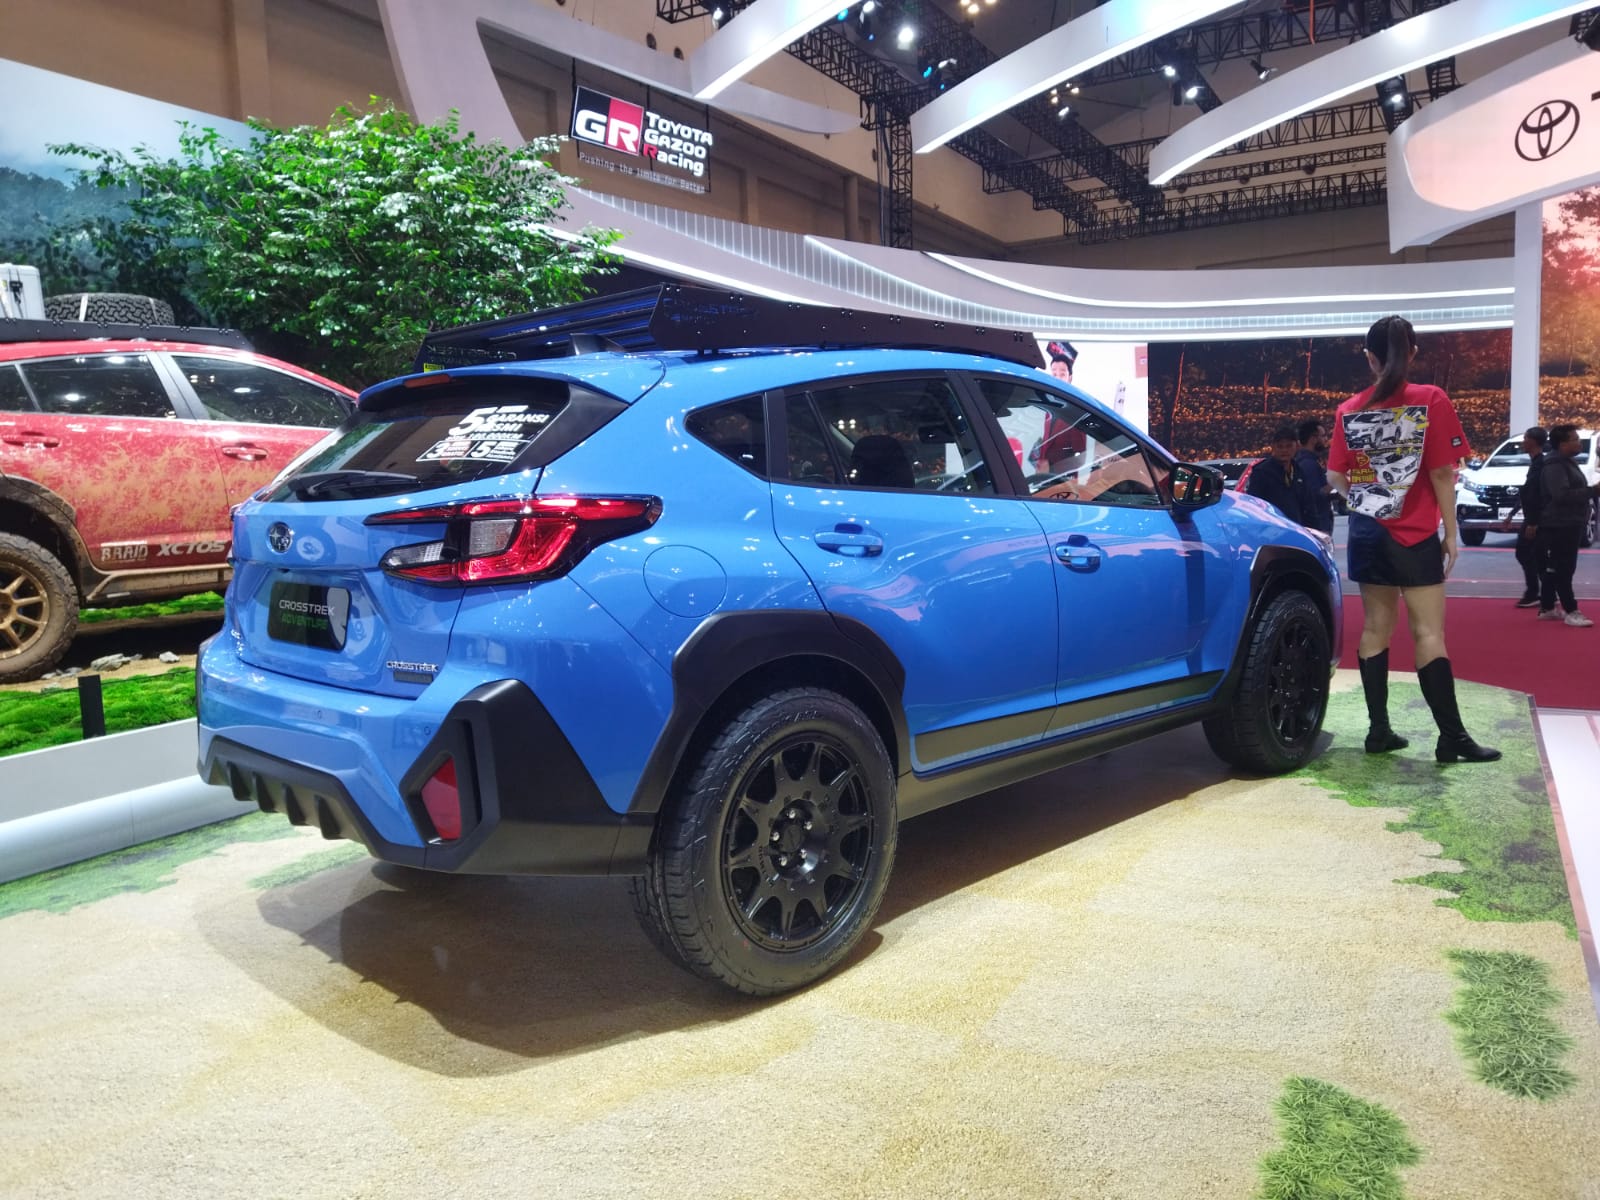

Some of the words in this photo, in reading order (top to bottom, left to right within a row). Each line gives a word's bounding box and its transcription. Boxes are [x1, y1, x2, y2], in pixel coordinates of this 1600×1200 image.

[575, 109, 639, 152] GR
[644, 128, 706, 159] GAZOO
[645, 111, 713, 146] TOYOTA
[579, 152, 615, 172] Pushing
[619, 162, 633, 175] the
[636, 168, 661, 182] limits
[664, 175, 676, 185] for
[643, 144, 704, 177] Racing
[448, 406, 498, 436] 5
[485, 413, 550, 424] GARANSI
[279, 599, 335, 617] CROSSTREK
[386, 660, 439, 673] CROSSTREK
